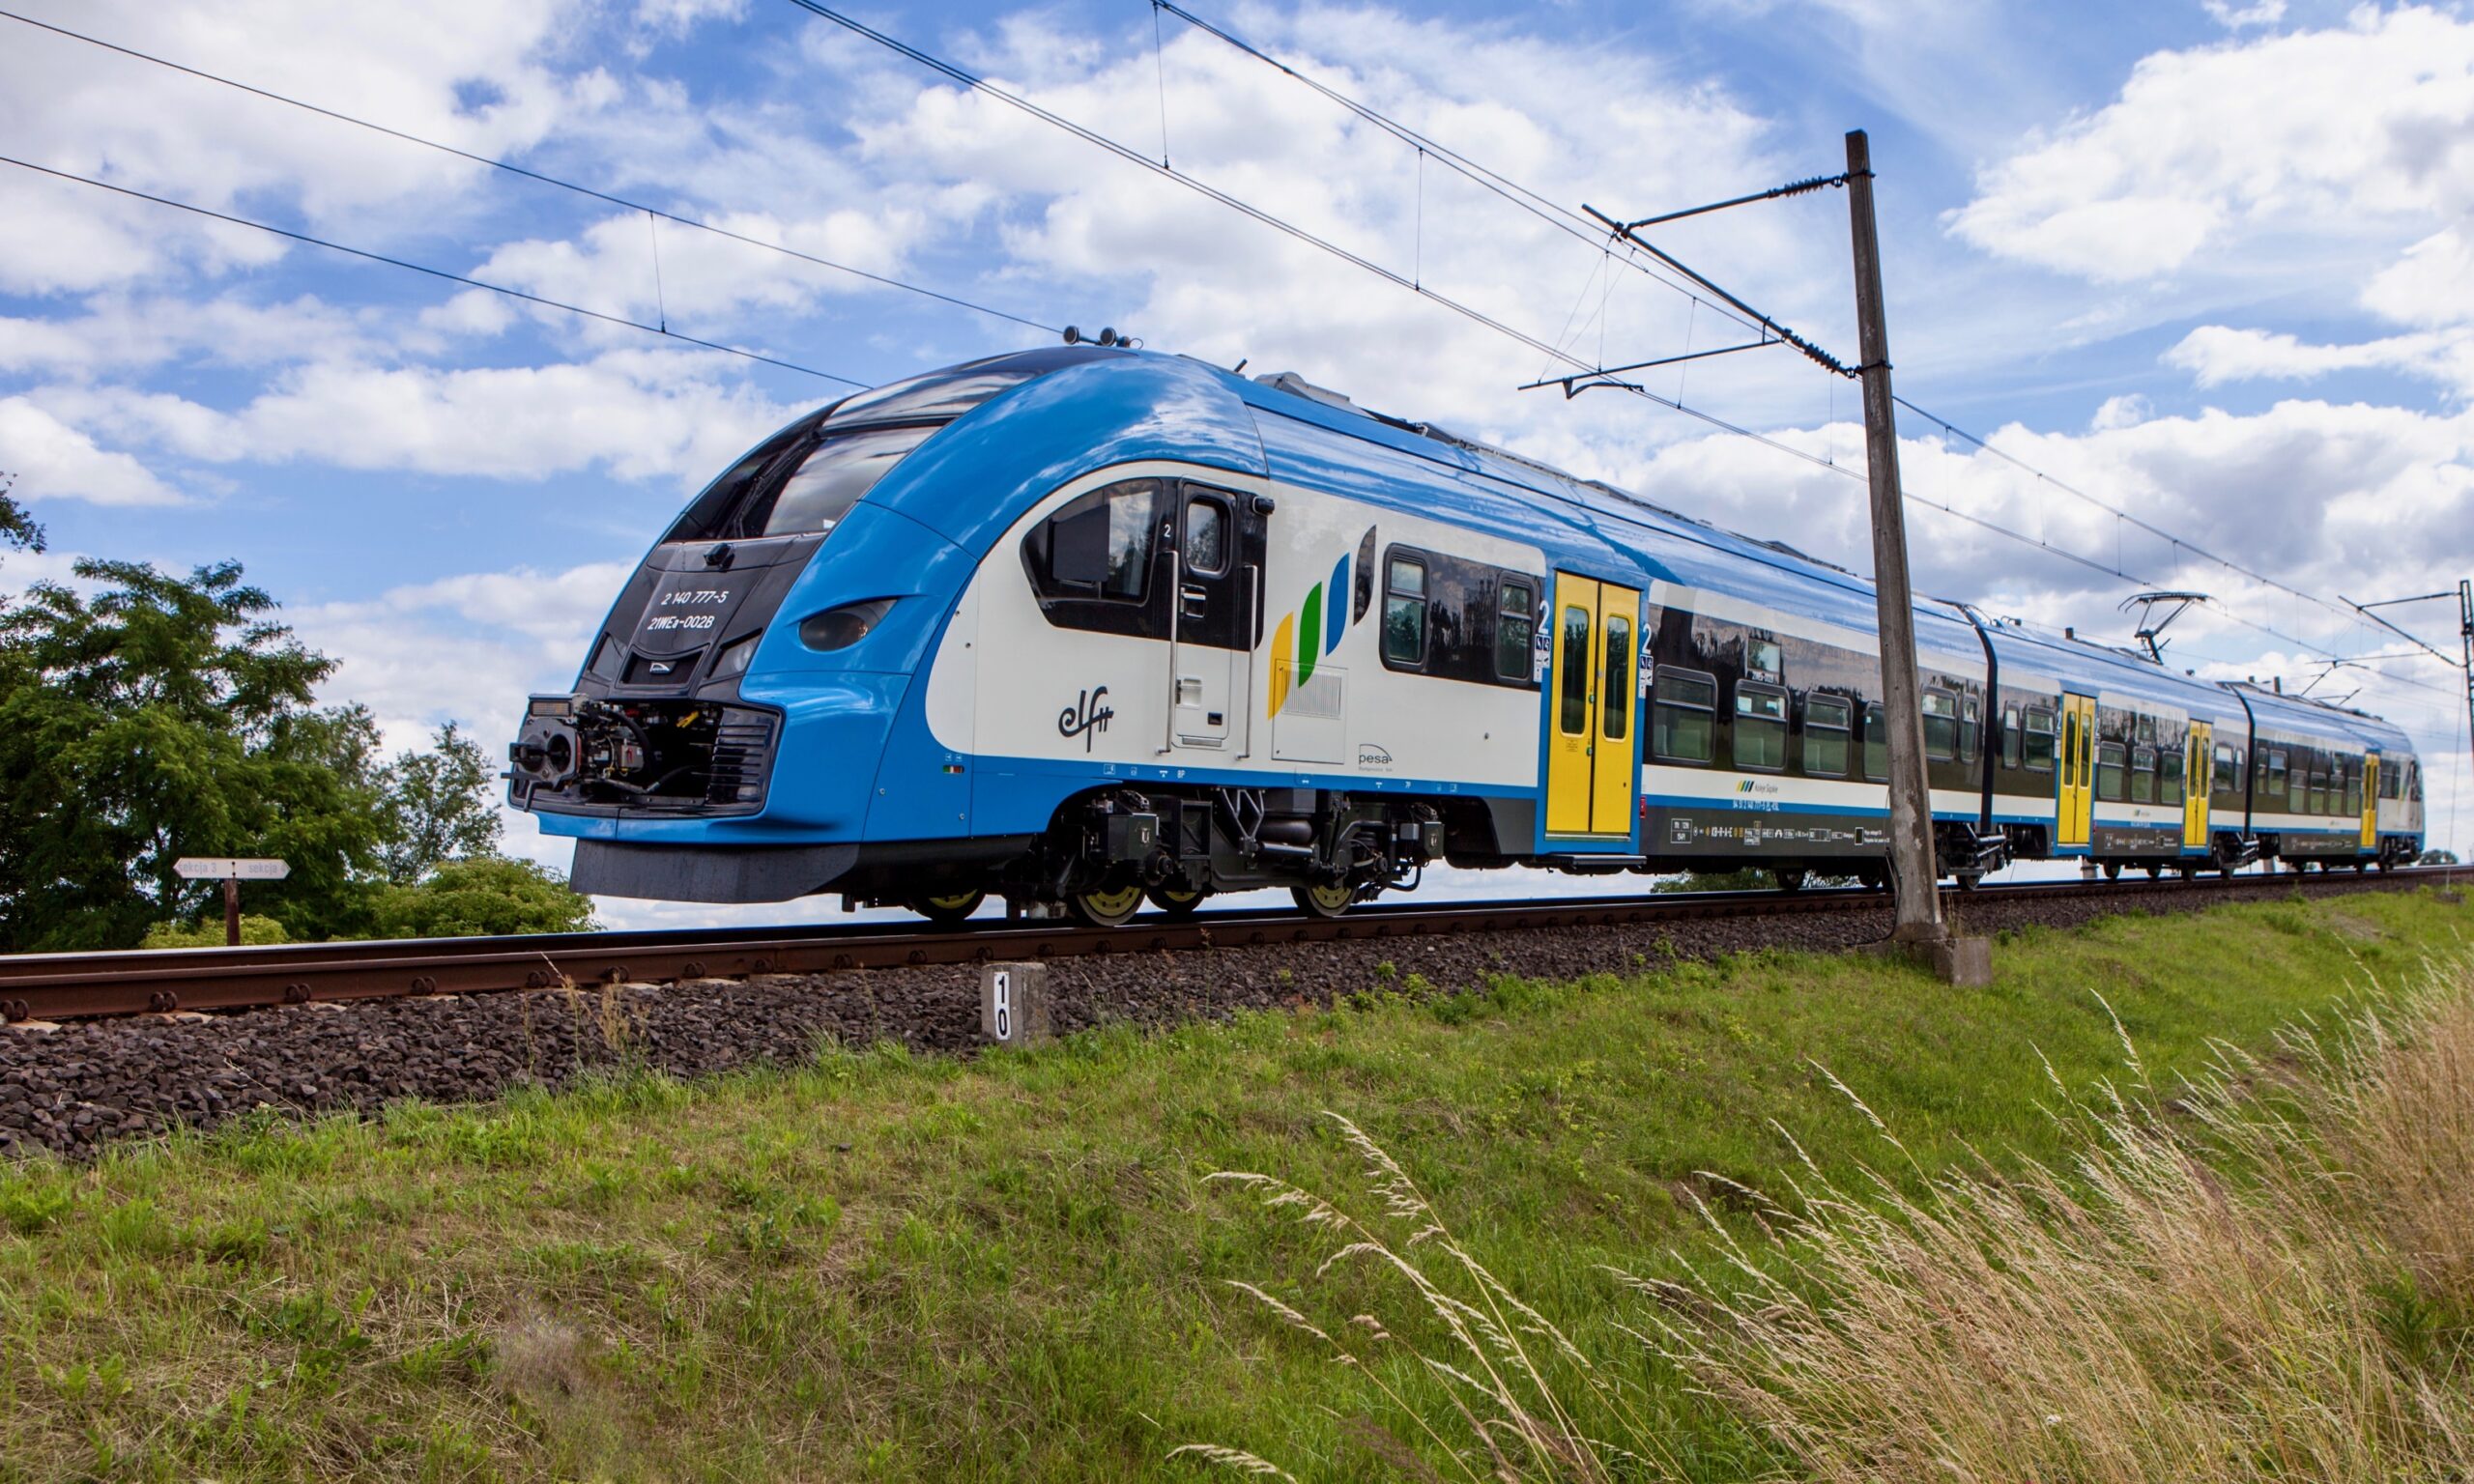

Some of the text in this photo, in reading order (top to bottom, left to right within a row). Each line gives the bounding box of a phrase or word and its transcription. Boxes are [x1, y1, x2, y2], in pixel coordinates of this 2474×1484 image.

[1165, 524, 1171, 537] 2
[661, 591, 729, 605] 2 140 777-5
[647, 615, 715, 630] 21WEa-002B
[1539, 600, 1550, 634] 2
[1642, 623, 1652, 655] 2
[1359, 755, 1389, 764] pesa
[248, 863, 277, 874] sekcja
